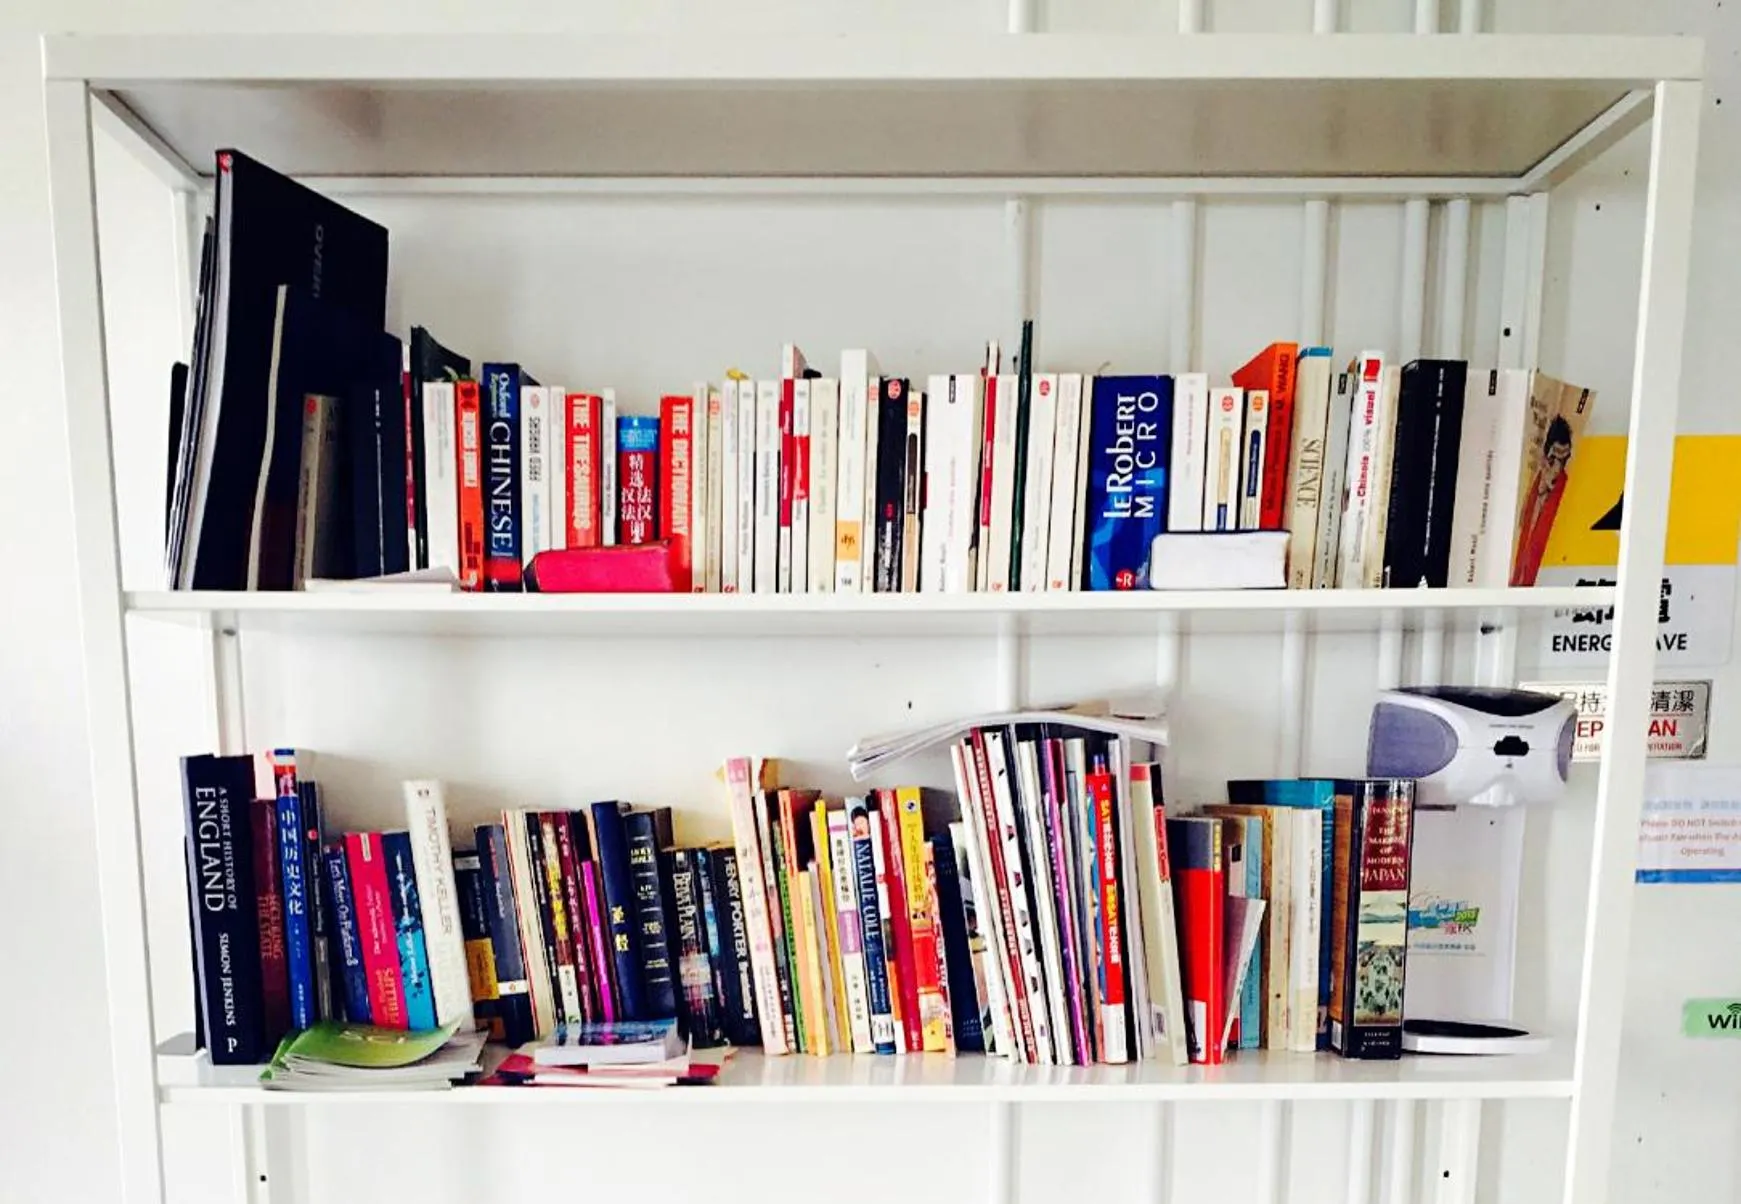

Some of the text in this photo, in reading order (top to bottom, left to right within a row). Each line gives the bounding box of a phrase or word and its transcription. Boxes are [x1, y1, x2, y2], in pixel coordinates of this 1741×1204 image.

[490, 422, 511, 546] CHINESE
[572, 397, 591, 530] THE THESAURUS
[671, 403, 689, 536] THE DICTIONARY
[1136, 392, 1159, 518] MICRO
[1296, 438, 1321, 508] SCIENCE
[1356, 455, 1370, 498] Chinois
[1577, 720, 1604, 737] EP
[195, 787, 226, 912] ENGLAND
[220, 798, 232, 838] SHORT
[221, 841, 236, 892] HISTORY
[424, 806, 454, 935] TIMOTHY KELLER
[724, 856, 741, 898] HENRY
[854, 843, 881, 941] NATALIE COLE
[1363, 868, 1405, 883] JAPAN
[730, 901, 749, 959] PORTER
[218, 933, 236, 1026] SIMON JENKINS
